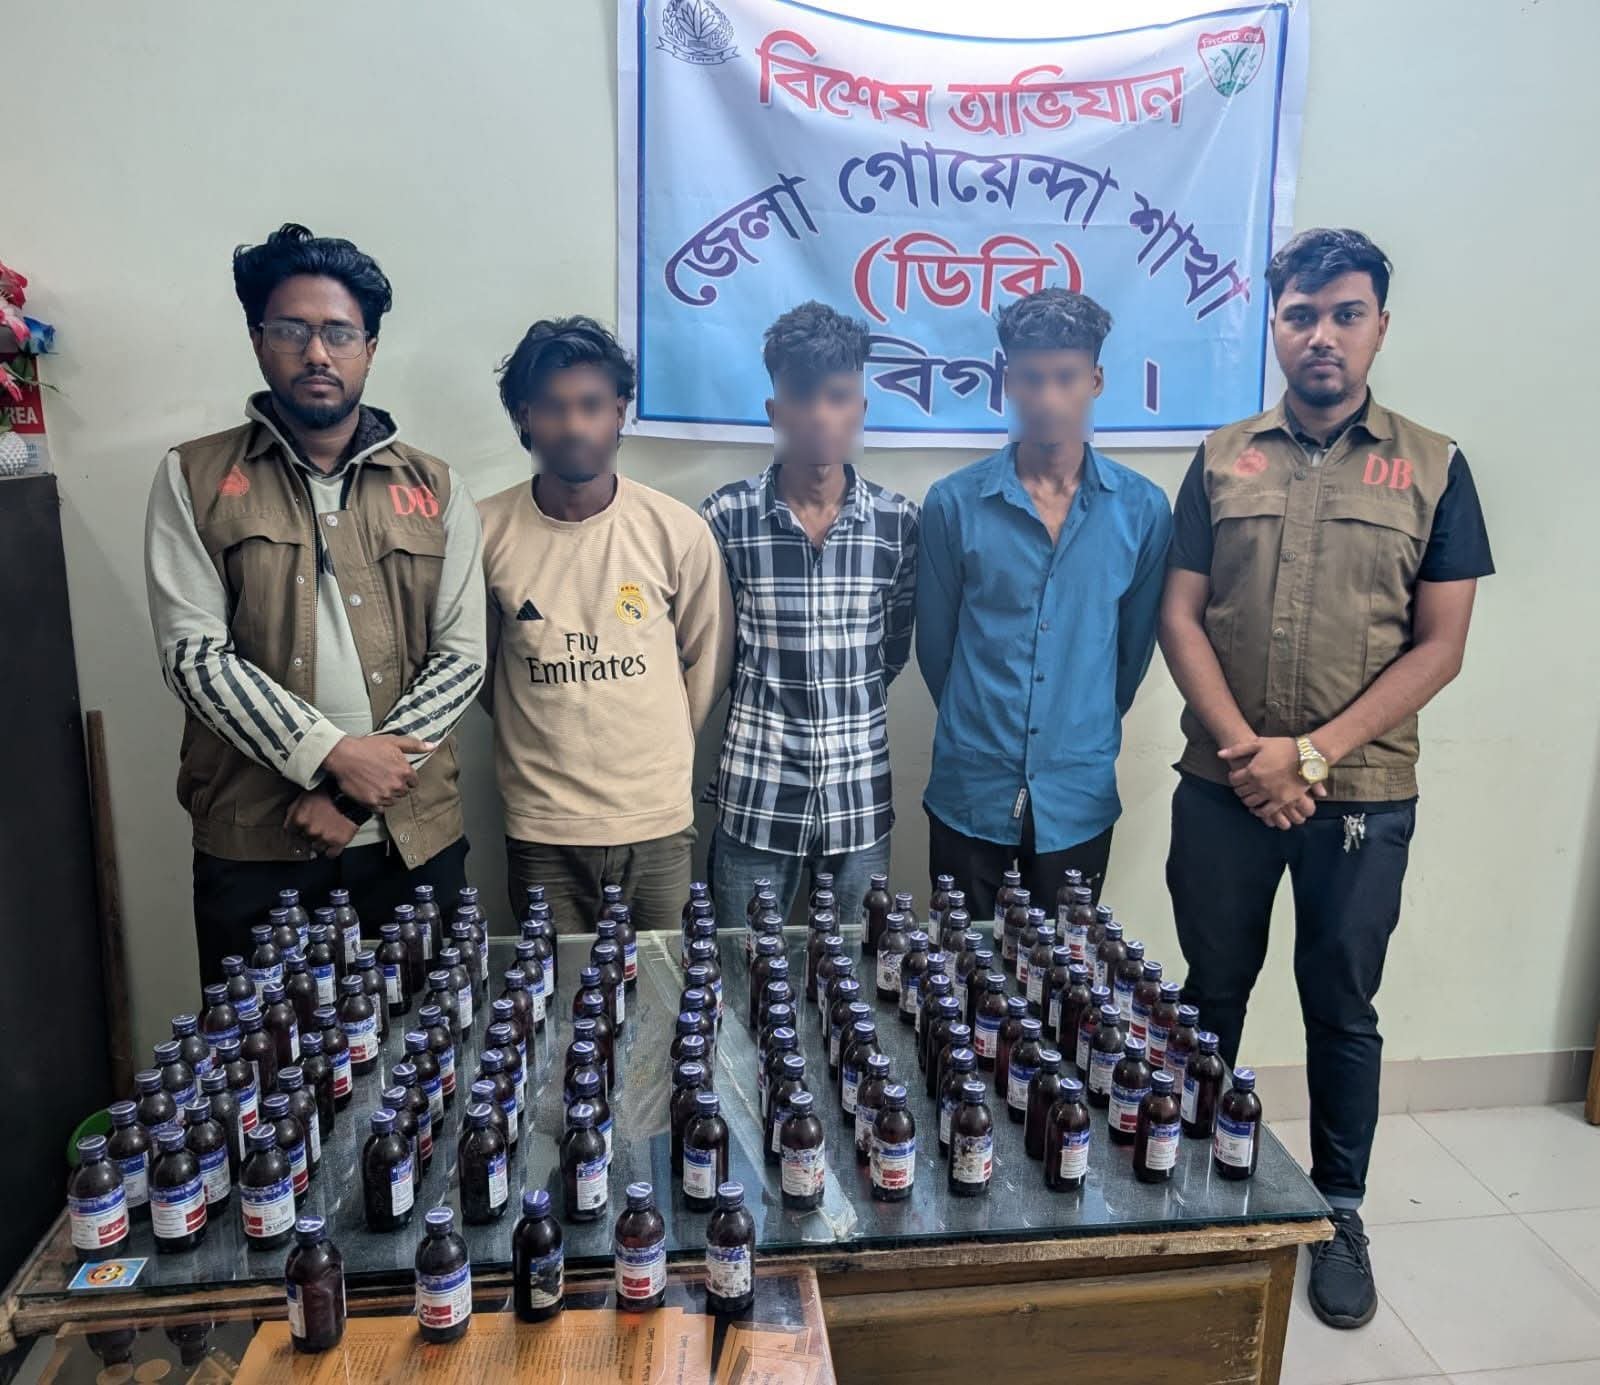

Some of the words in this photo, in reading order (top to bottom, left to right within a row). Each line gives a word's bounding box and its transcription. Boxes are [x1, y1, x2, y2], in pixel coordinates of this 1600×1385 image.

[755, 30, 932, 128] বিশেষ
[948, 64, 1184, 135] অভিযান
[665, 173, 819, 306] জেলা
[839, 140, 1119, 231] গোয়েন্দা
[1129, 191, 1250, 320] শাখা
[3, 406, 39, 425] REA
[1362, 453, 1414, 490] DB
[565, 632, 598, 654] Fly
[526, 654, 647, 685] Emirates
